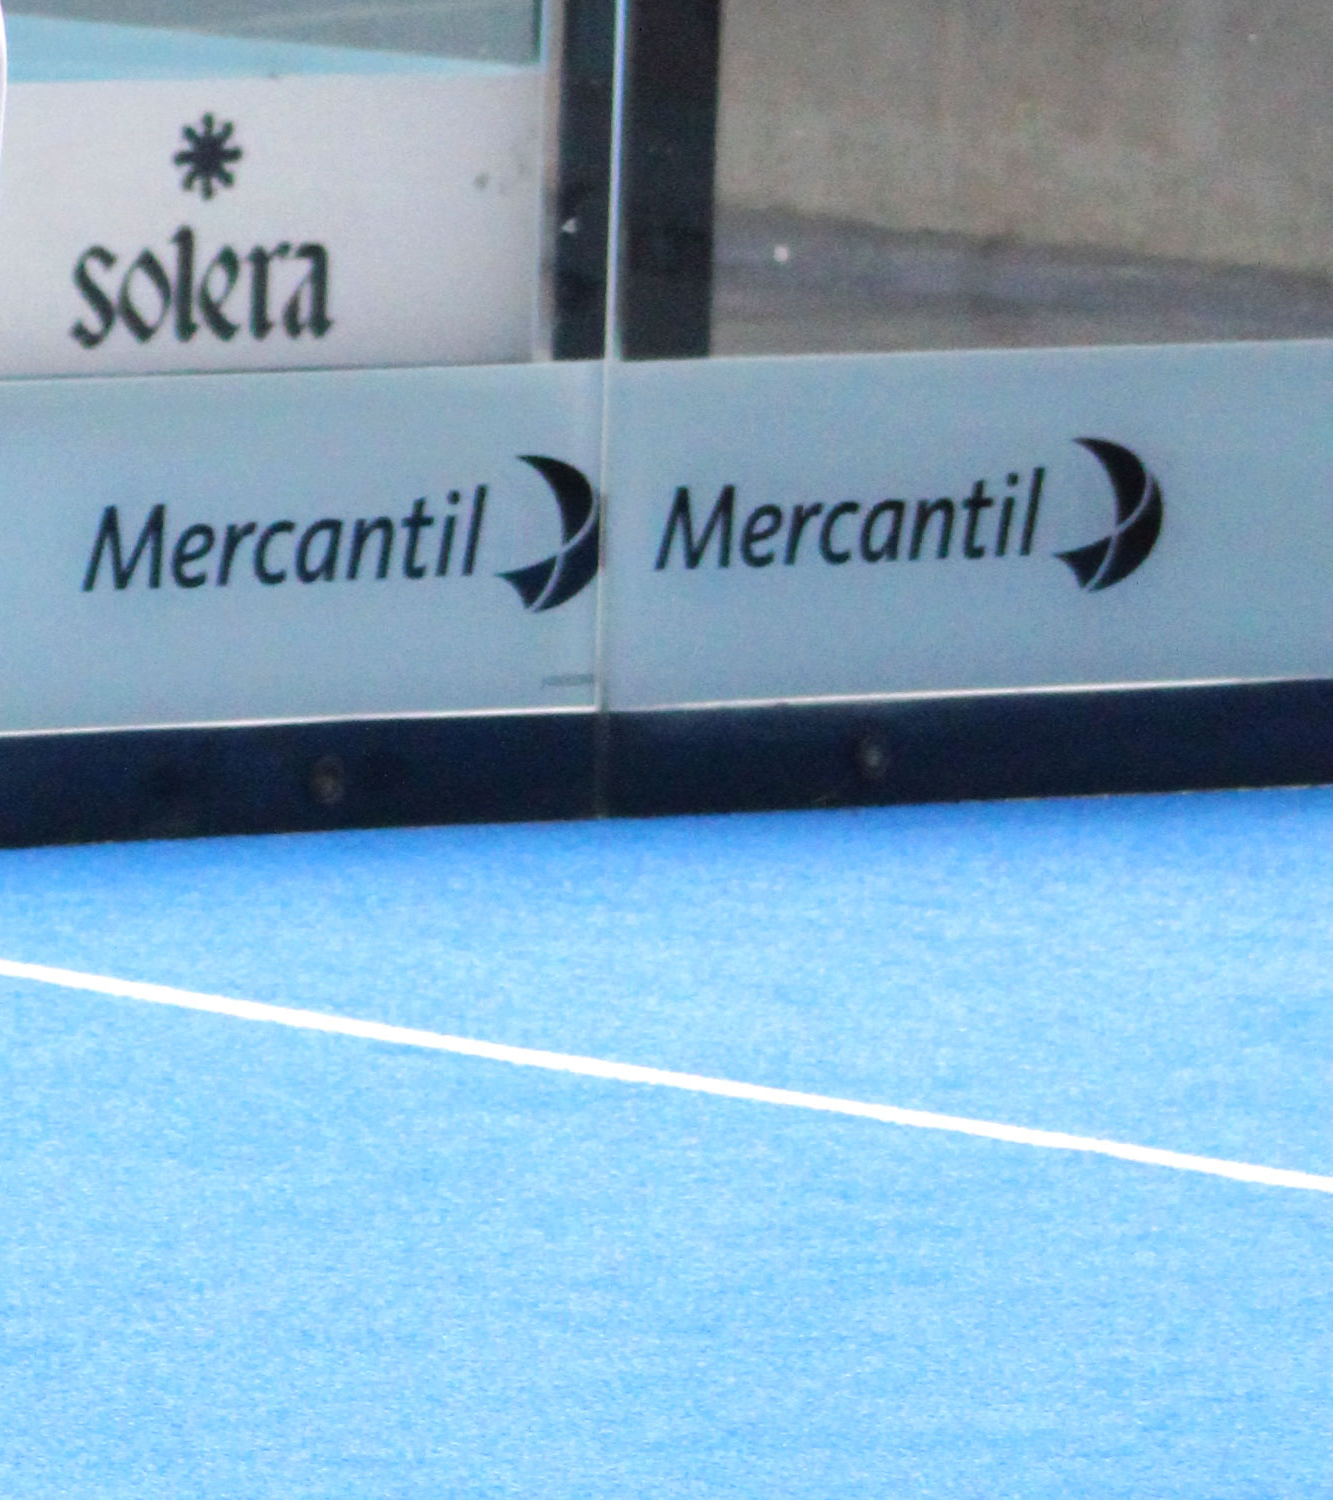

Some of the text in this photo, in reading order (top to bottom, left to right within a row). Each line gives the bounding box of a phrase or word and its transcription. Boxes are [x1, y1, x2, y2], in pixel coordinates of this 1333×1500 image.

[71, 226, 334, 348] solera
[82, 484, 489, 593] Mercantil
[654, 466, 1047, 572] Mercantil
